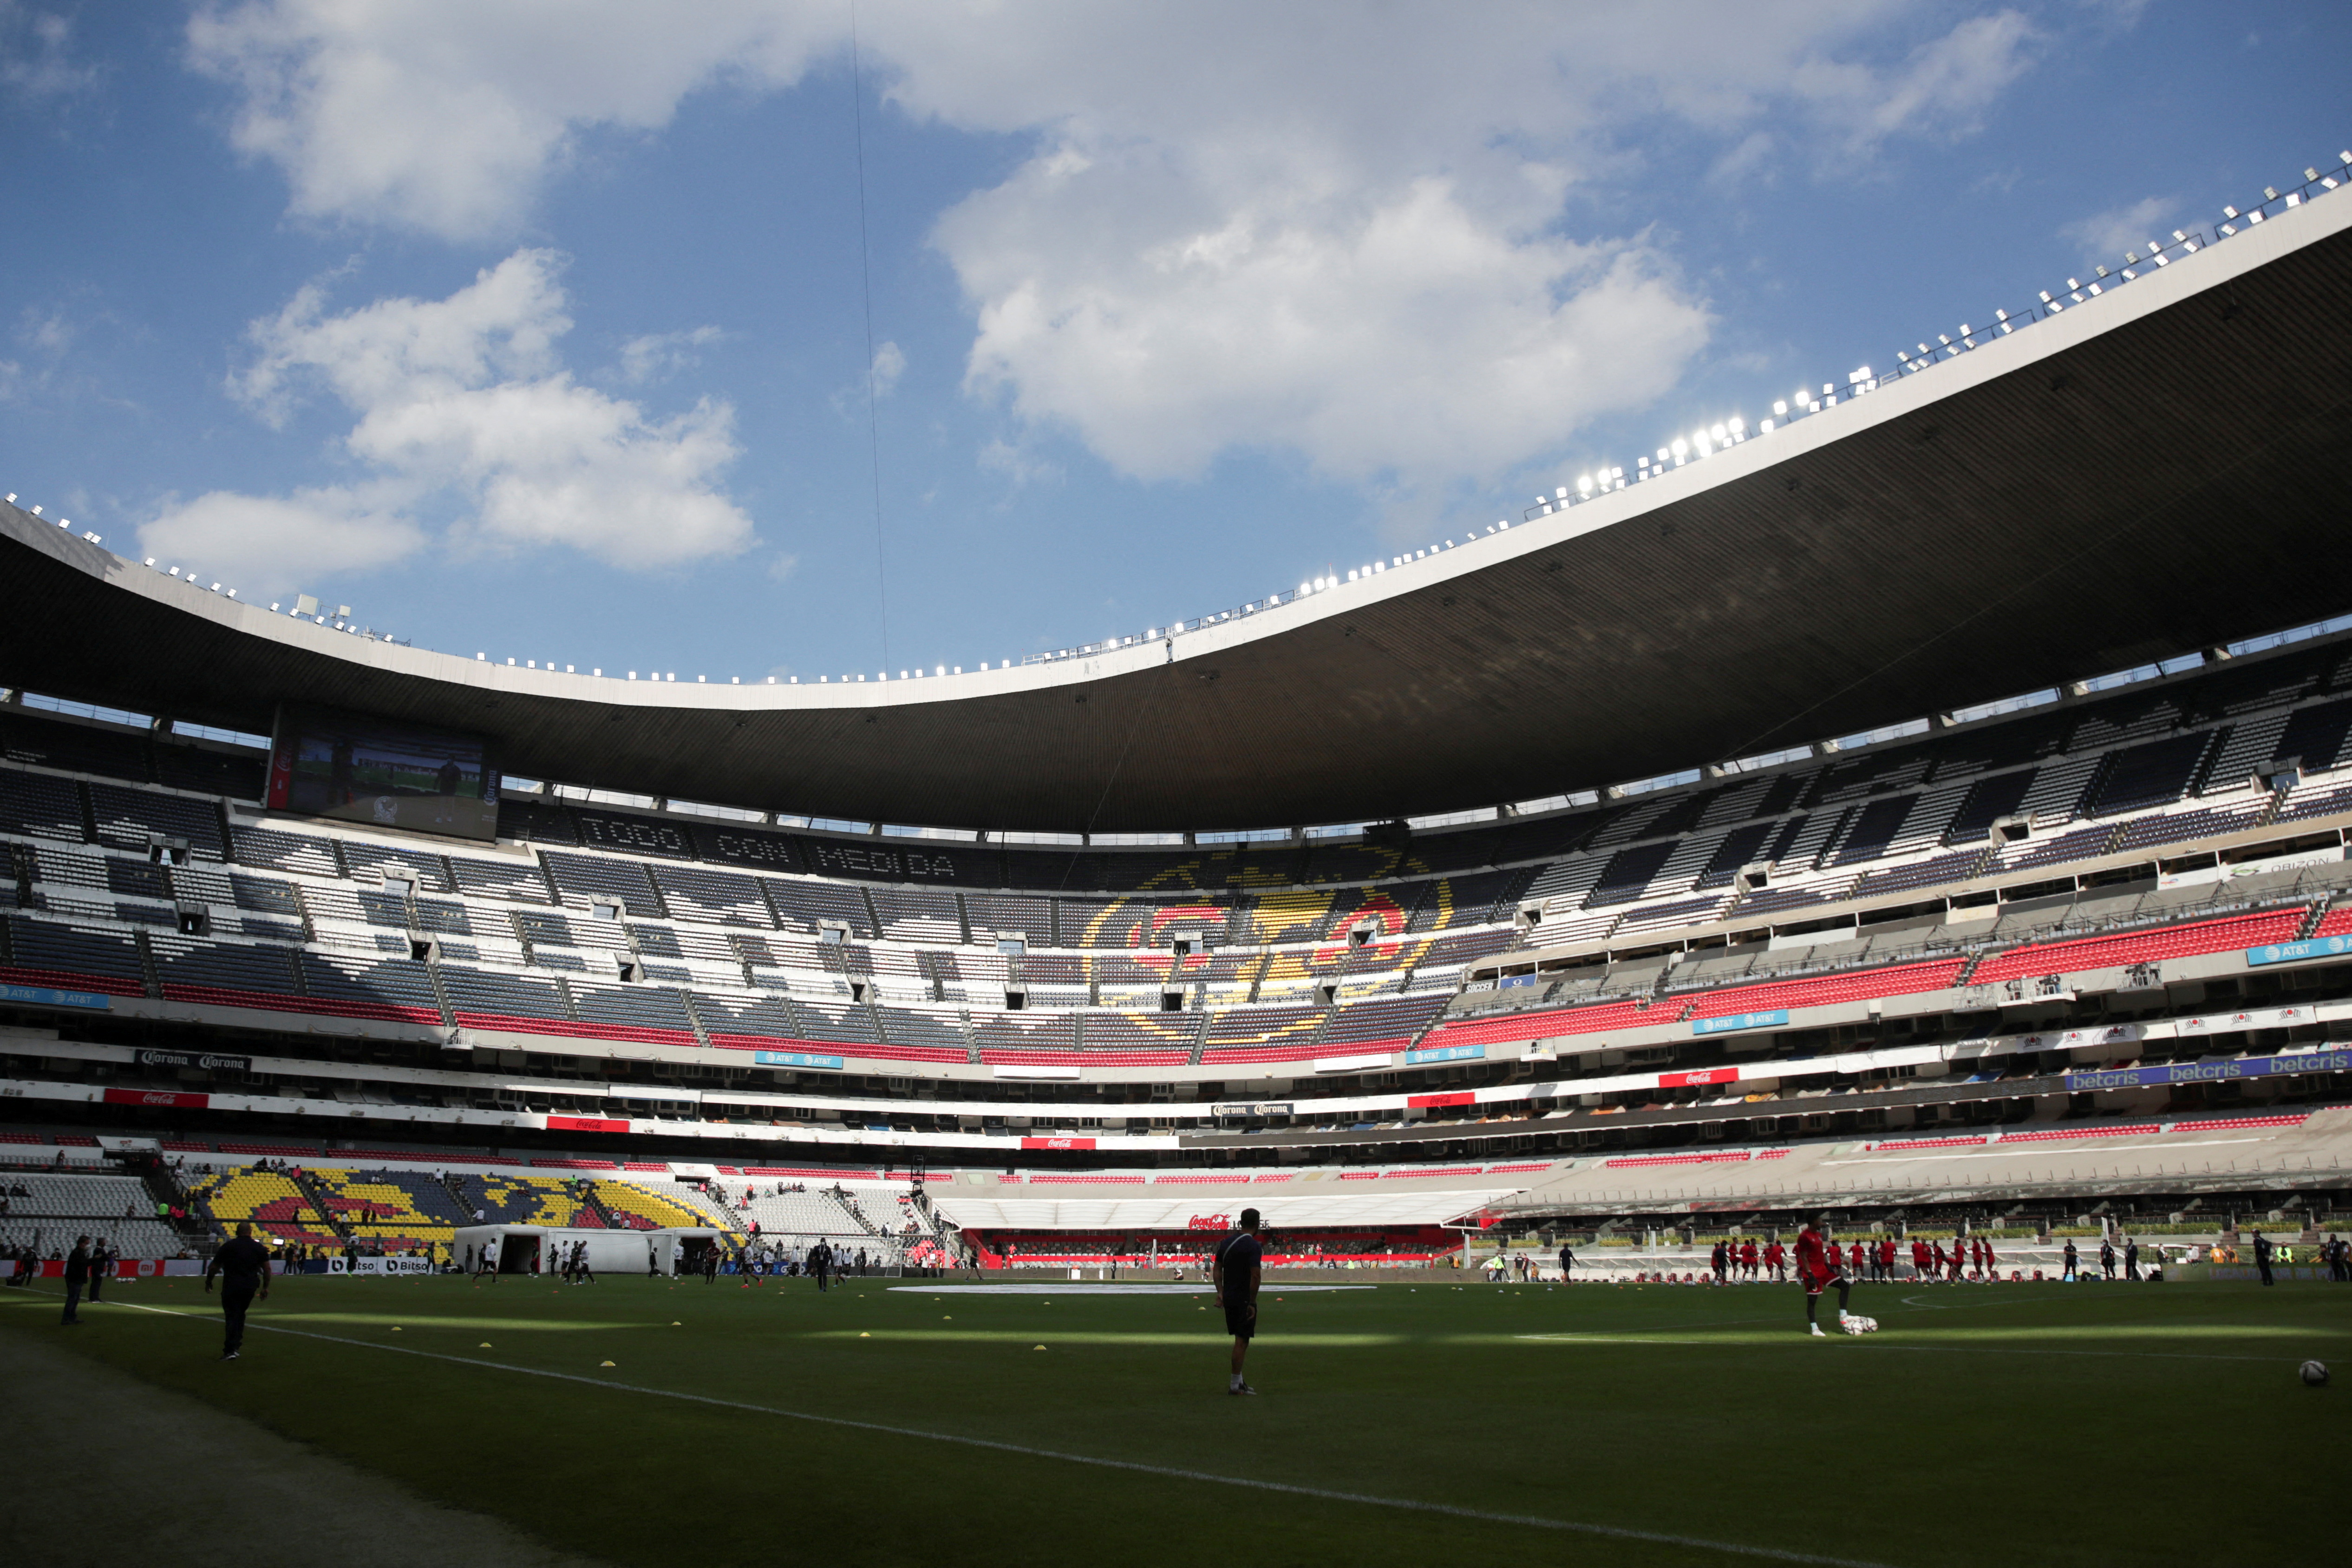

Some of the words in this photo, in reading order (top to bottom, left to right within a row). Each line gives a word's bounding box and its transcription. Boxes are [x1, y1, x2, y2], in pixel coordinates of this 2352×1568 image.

[483, 770, 497, 806] Corona
[581, 817, 681, 849] TODO
[717, 835, 789, 862] CON
[816, 846, 954, 875] MEDIDA
[2282, 944, 2311, 956] AT&T
[1465, 982, 1494, 993] SOCCER
[11, 989, 37, 999] AT&T
[67, 995, 92, 1004] AT&T
[1715, 1019, 1734, 1028] AT&T
[1756, 1013, 1776, 1023] AT&T
[141, 1051, 188, 1065] Corona
[199, 1055, 245, 1069] Corona
[2073, 1071, 2139, 1089] betcris
[2169, 1062, 2241, 1081] betcris
[2270, 1052, 2348, 1073] betcris
[1213, 1105, 1247, 1117] Corona
[1254, 1104, 1288, 1116] Corona
[401, 1261, 427, 1270] Bitso
